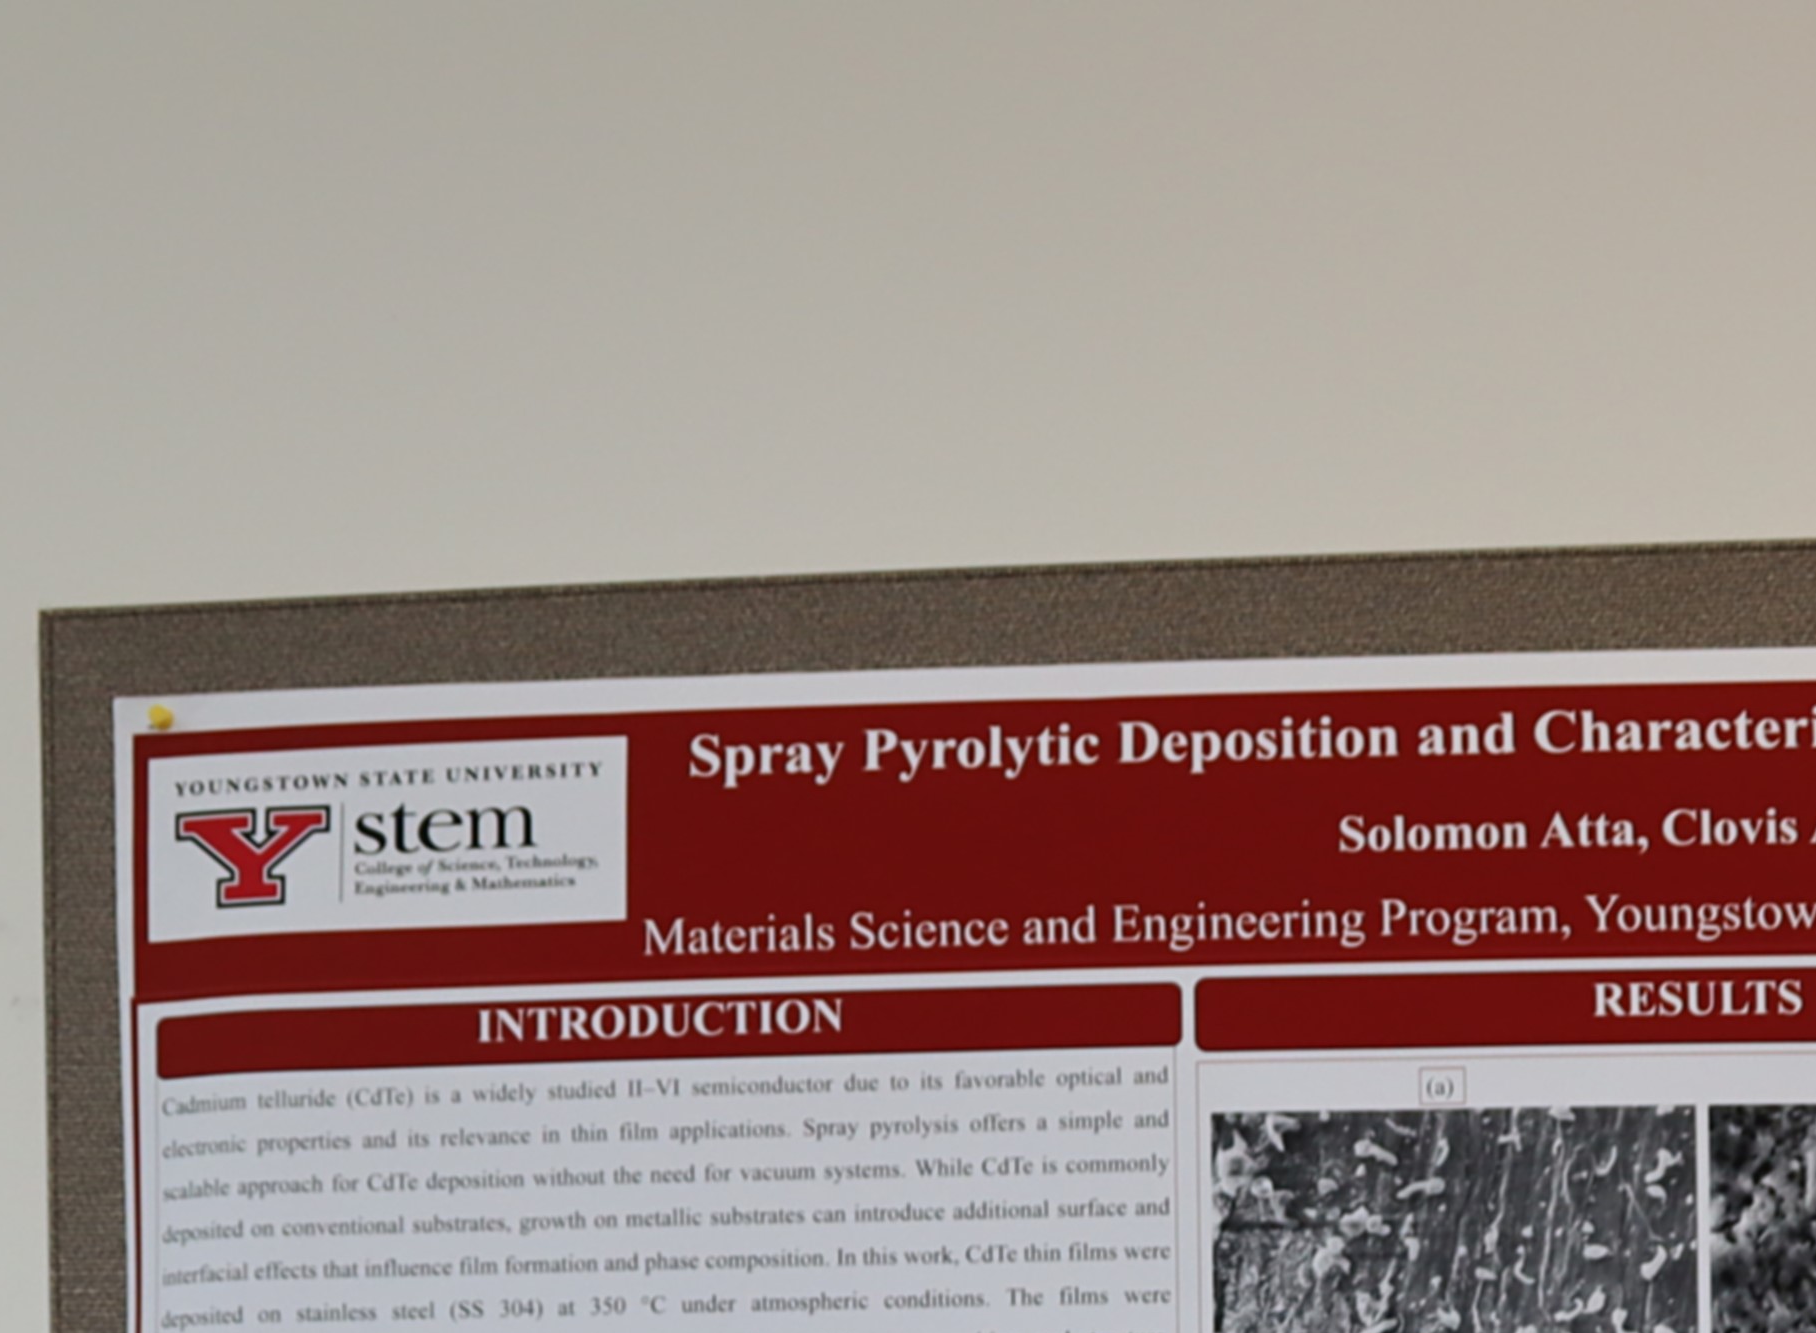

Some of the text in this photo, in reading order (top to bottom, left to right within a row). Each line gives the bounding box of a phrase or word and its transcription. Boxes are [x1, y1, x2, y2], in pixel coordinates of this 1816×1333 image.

[690, 733, 845, 791] Spray
[865, 722, 1101, 785] Pyrolytic
[1120, 715, 1399, 776] Deposition
[1418, 712, 1517, 758] and
[175, 762, 602, 799] YOUNGSTOWN STATE UNIVERSITY
[355, 802, 537, 856] stem
[1340, 814, 1528, 855] Solomon
[1541, 812, 1650, 855] Atta,
[1662, 807, 1799, 848] Clovis
[175, 805, 331, 908] Y
[355, 875, 578, 899] Engineering & Mathematics
[645, 913, 837, 958] Materials
[851, 909, 1010, 952] Science
[1023, 903, 1098, 947] and
[1114, 900, 1367, 954] Engineering
[1382, 899, 1572, 948] Program,
[480, 998, 843, 1045] INTRODUCTION
[1595, 980, 1804, 1019] RESULTS
[162, 1096, 249, 1119] Cadmium
[258, 1088, 338, 1112] telluride
[346, 1086, 416, 1110] (CdTe)
[425, 1090, 442, 1106] is
[451, 1089, 463, 1106] a
[473, 1083, 537, 1108] widely
[548, 1079, 618, 1102] studied
[692, 1074, 835, 1099] semiconductor
[844, 1072, 881, 1095] due
[890, 1075, 911, 1093] to
[921, 1074, 945, 1092] its
[955, 1068, 1047, 1092] favorable
[1056, 1066, 1124, 1094] optical
[1133, 1065, 1171, 1088] and
[1426, 1079, 1456, 1101] (a)
